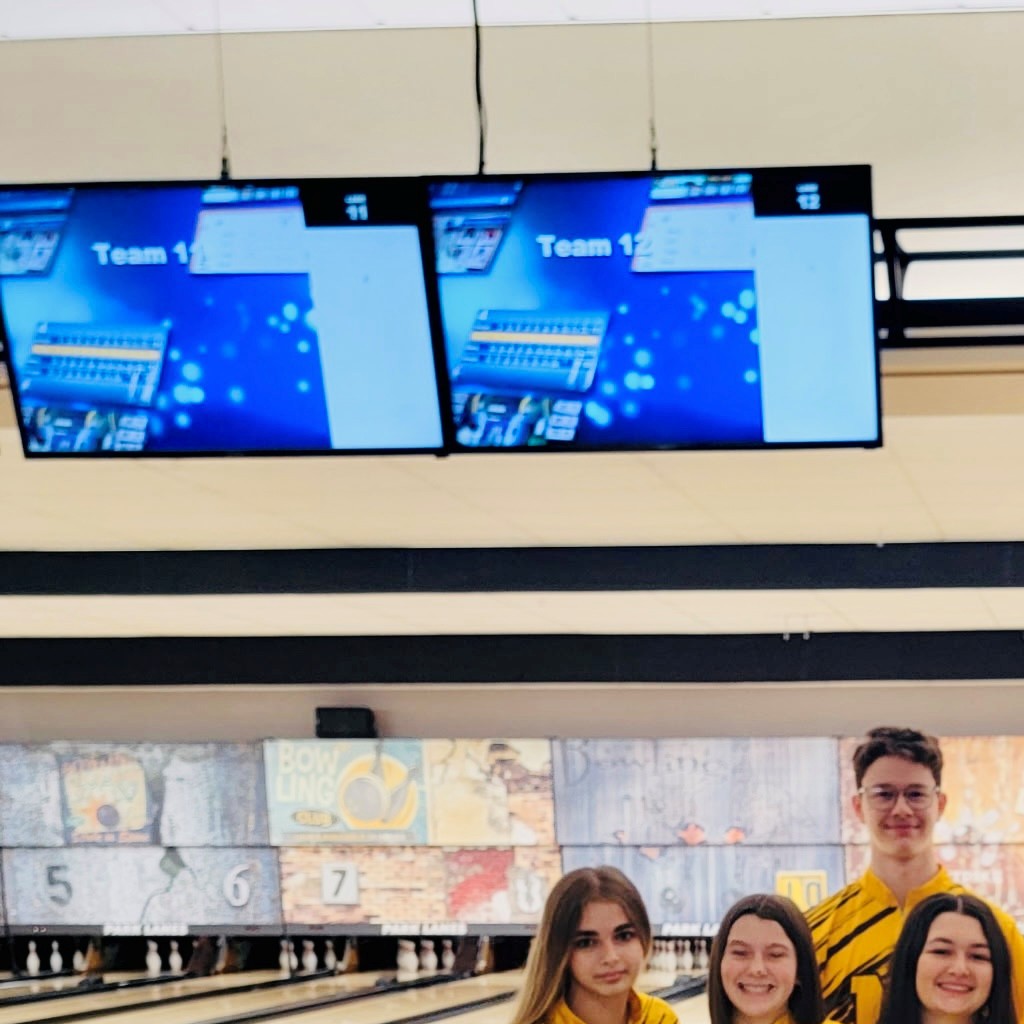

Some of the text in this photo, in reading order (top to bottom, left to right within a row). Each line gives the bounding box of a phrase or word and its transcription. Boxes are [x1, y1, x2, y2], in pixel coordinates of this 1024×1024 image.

[345, 205, 369, 221] 11
[796, 194, 821, 210] 12
[91, 241, 168, 266] Team
[536, 234, 613, 258] Team
[279, 743, 340, 775] BOW
[276, 773, 336, 807] LING
[46, 864, 73, 906] 5
[223, 863, 252, 908] 6
[331, 869, 347, 897] 7
[660, 922, 702, 937] PARK
